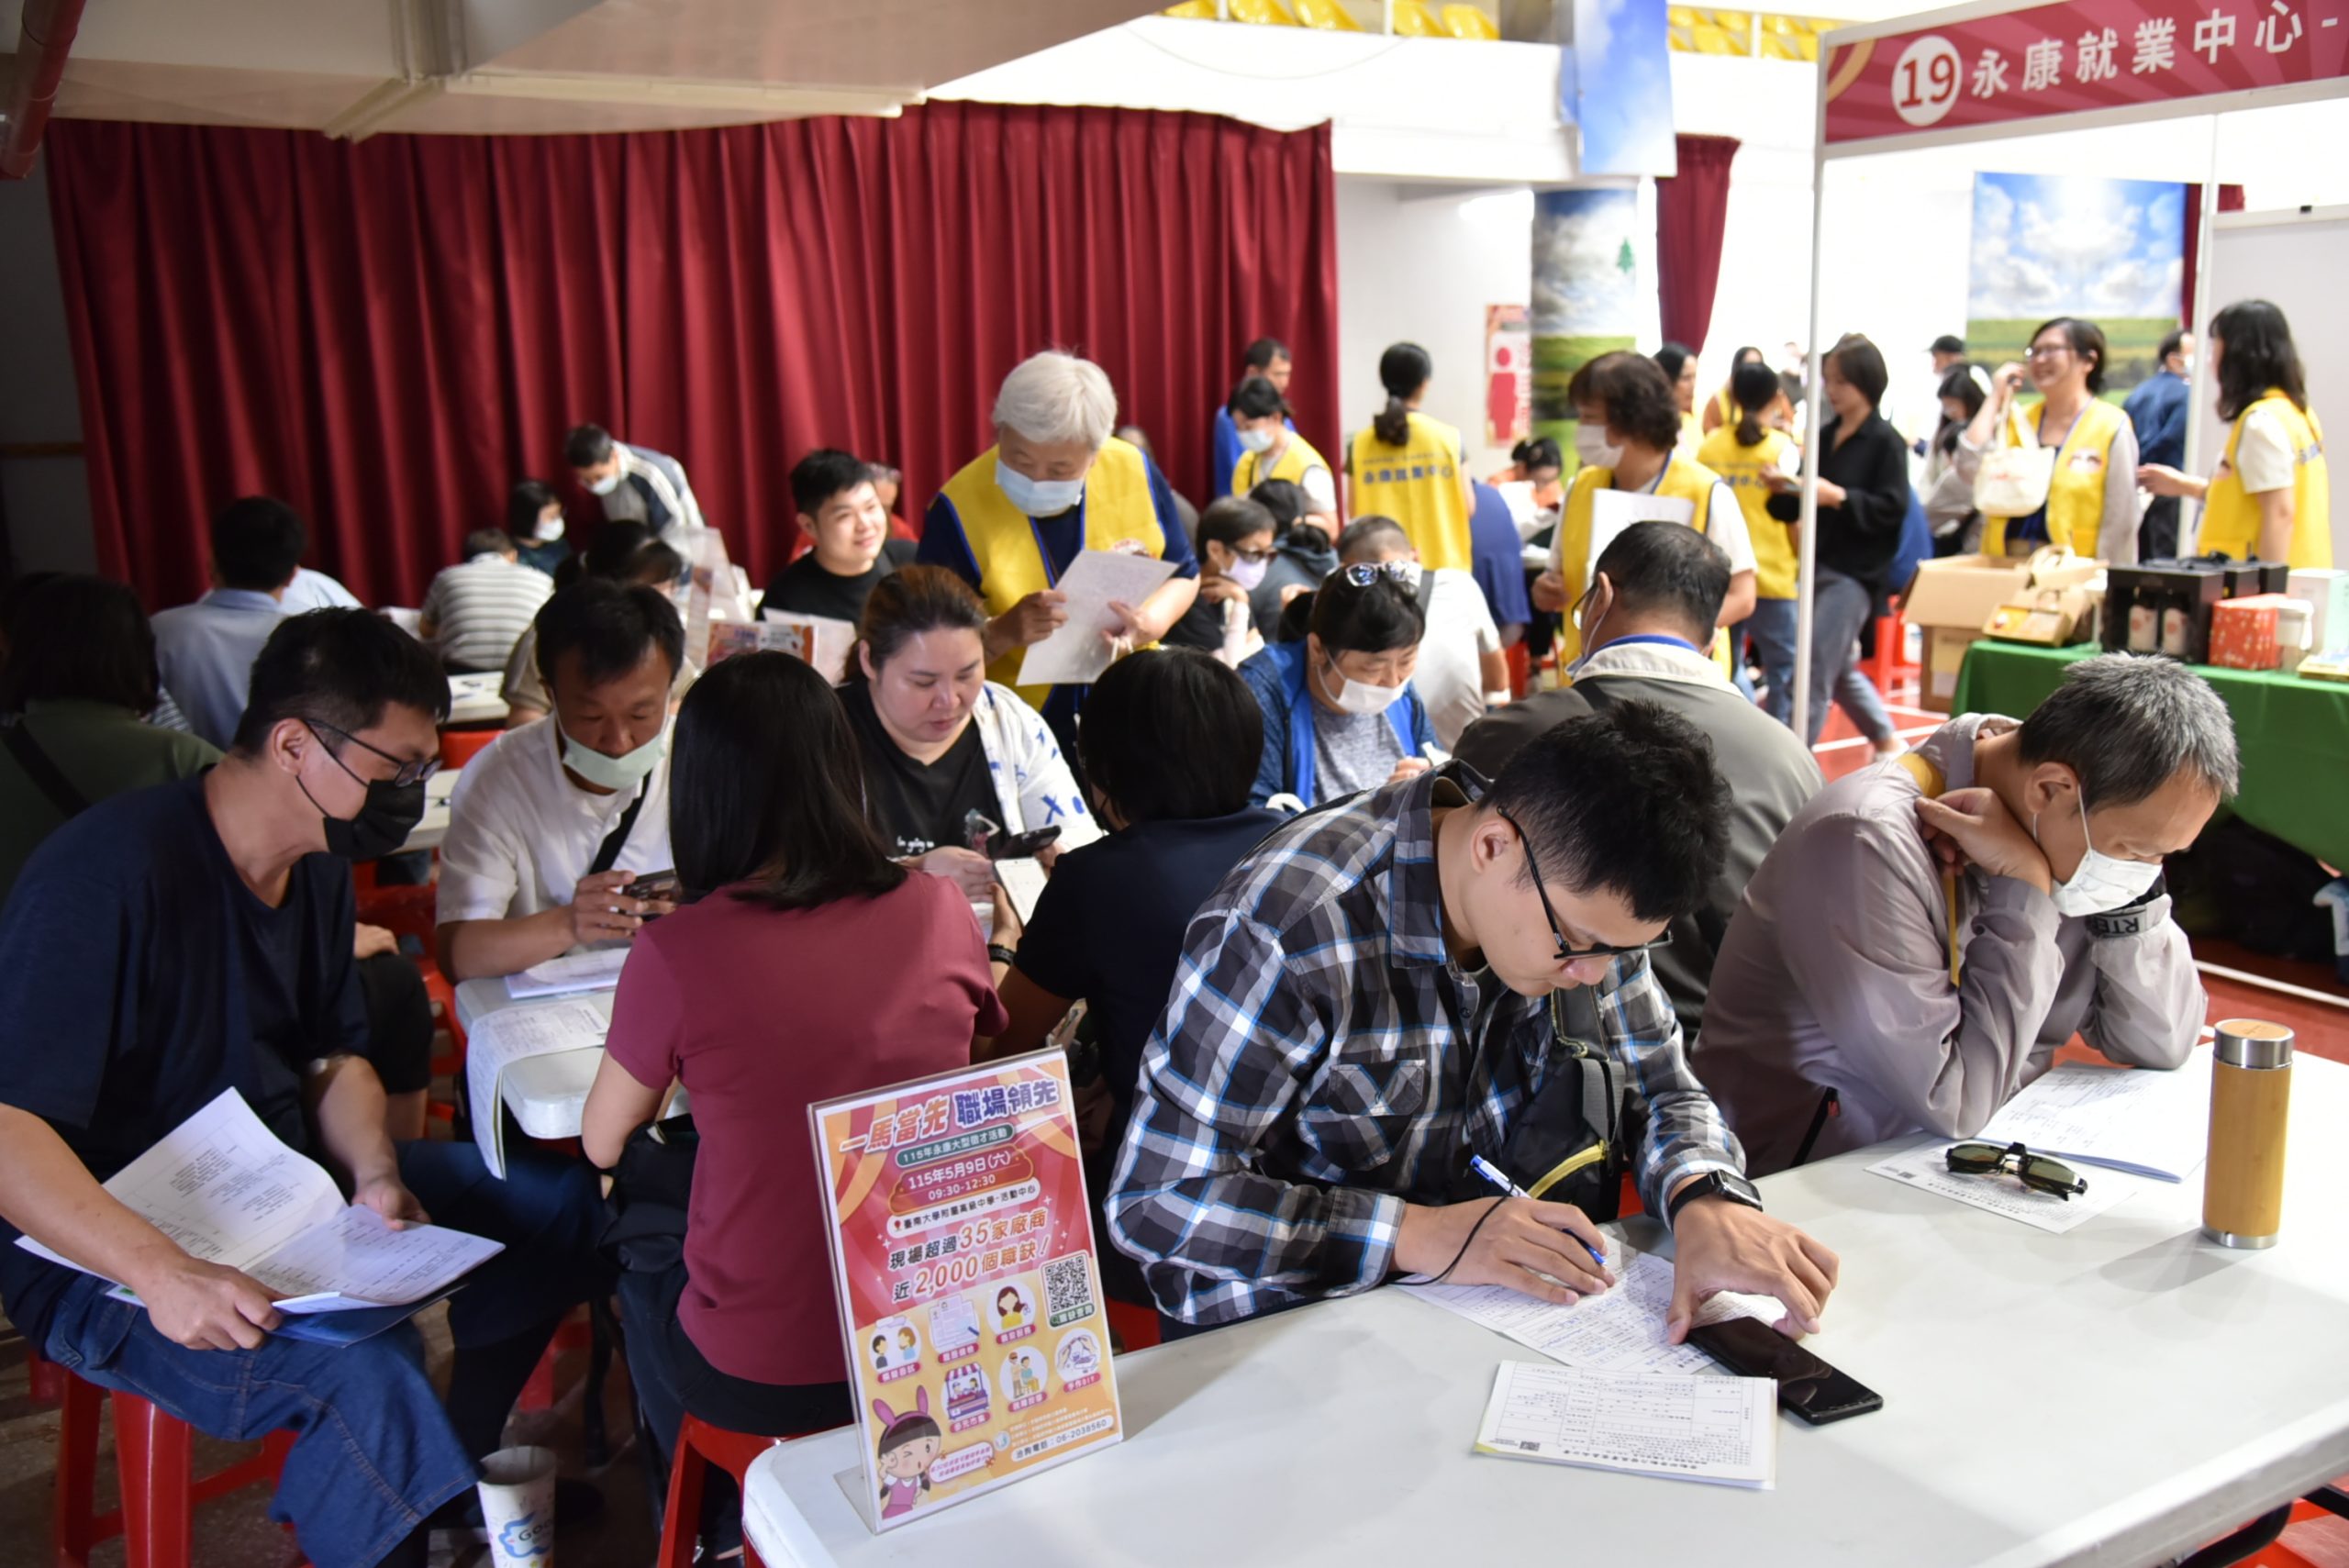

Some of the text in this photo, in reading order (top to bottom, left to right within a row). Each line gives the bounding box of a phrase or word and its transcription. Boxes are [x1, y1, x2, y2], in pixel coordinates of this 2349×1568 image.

[1898, 53, 1955, 109] 19
[840, 1080, 1059, 1152] 一馬當先 職場領先
[908, 1150, 1010, 1190] 115年5月9日(六)
[928, 1173, 996, 1201] 09:30-12:30
[889, 1207, 1048, 1271] 現場超過35家廠商
